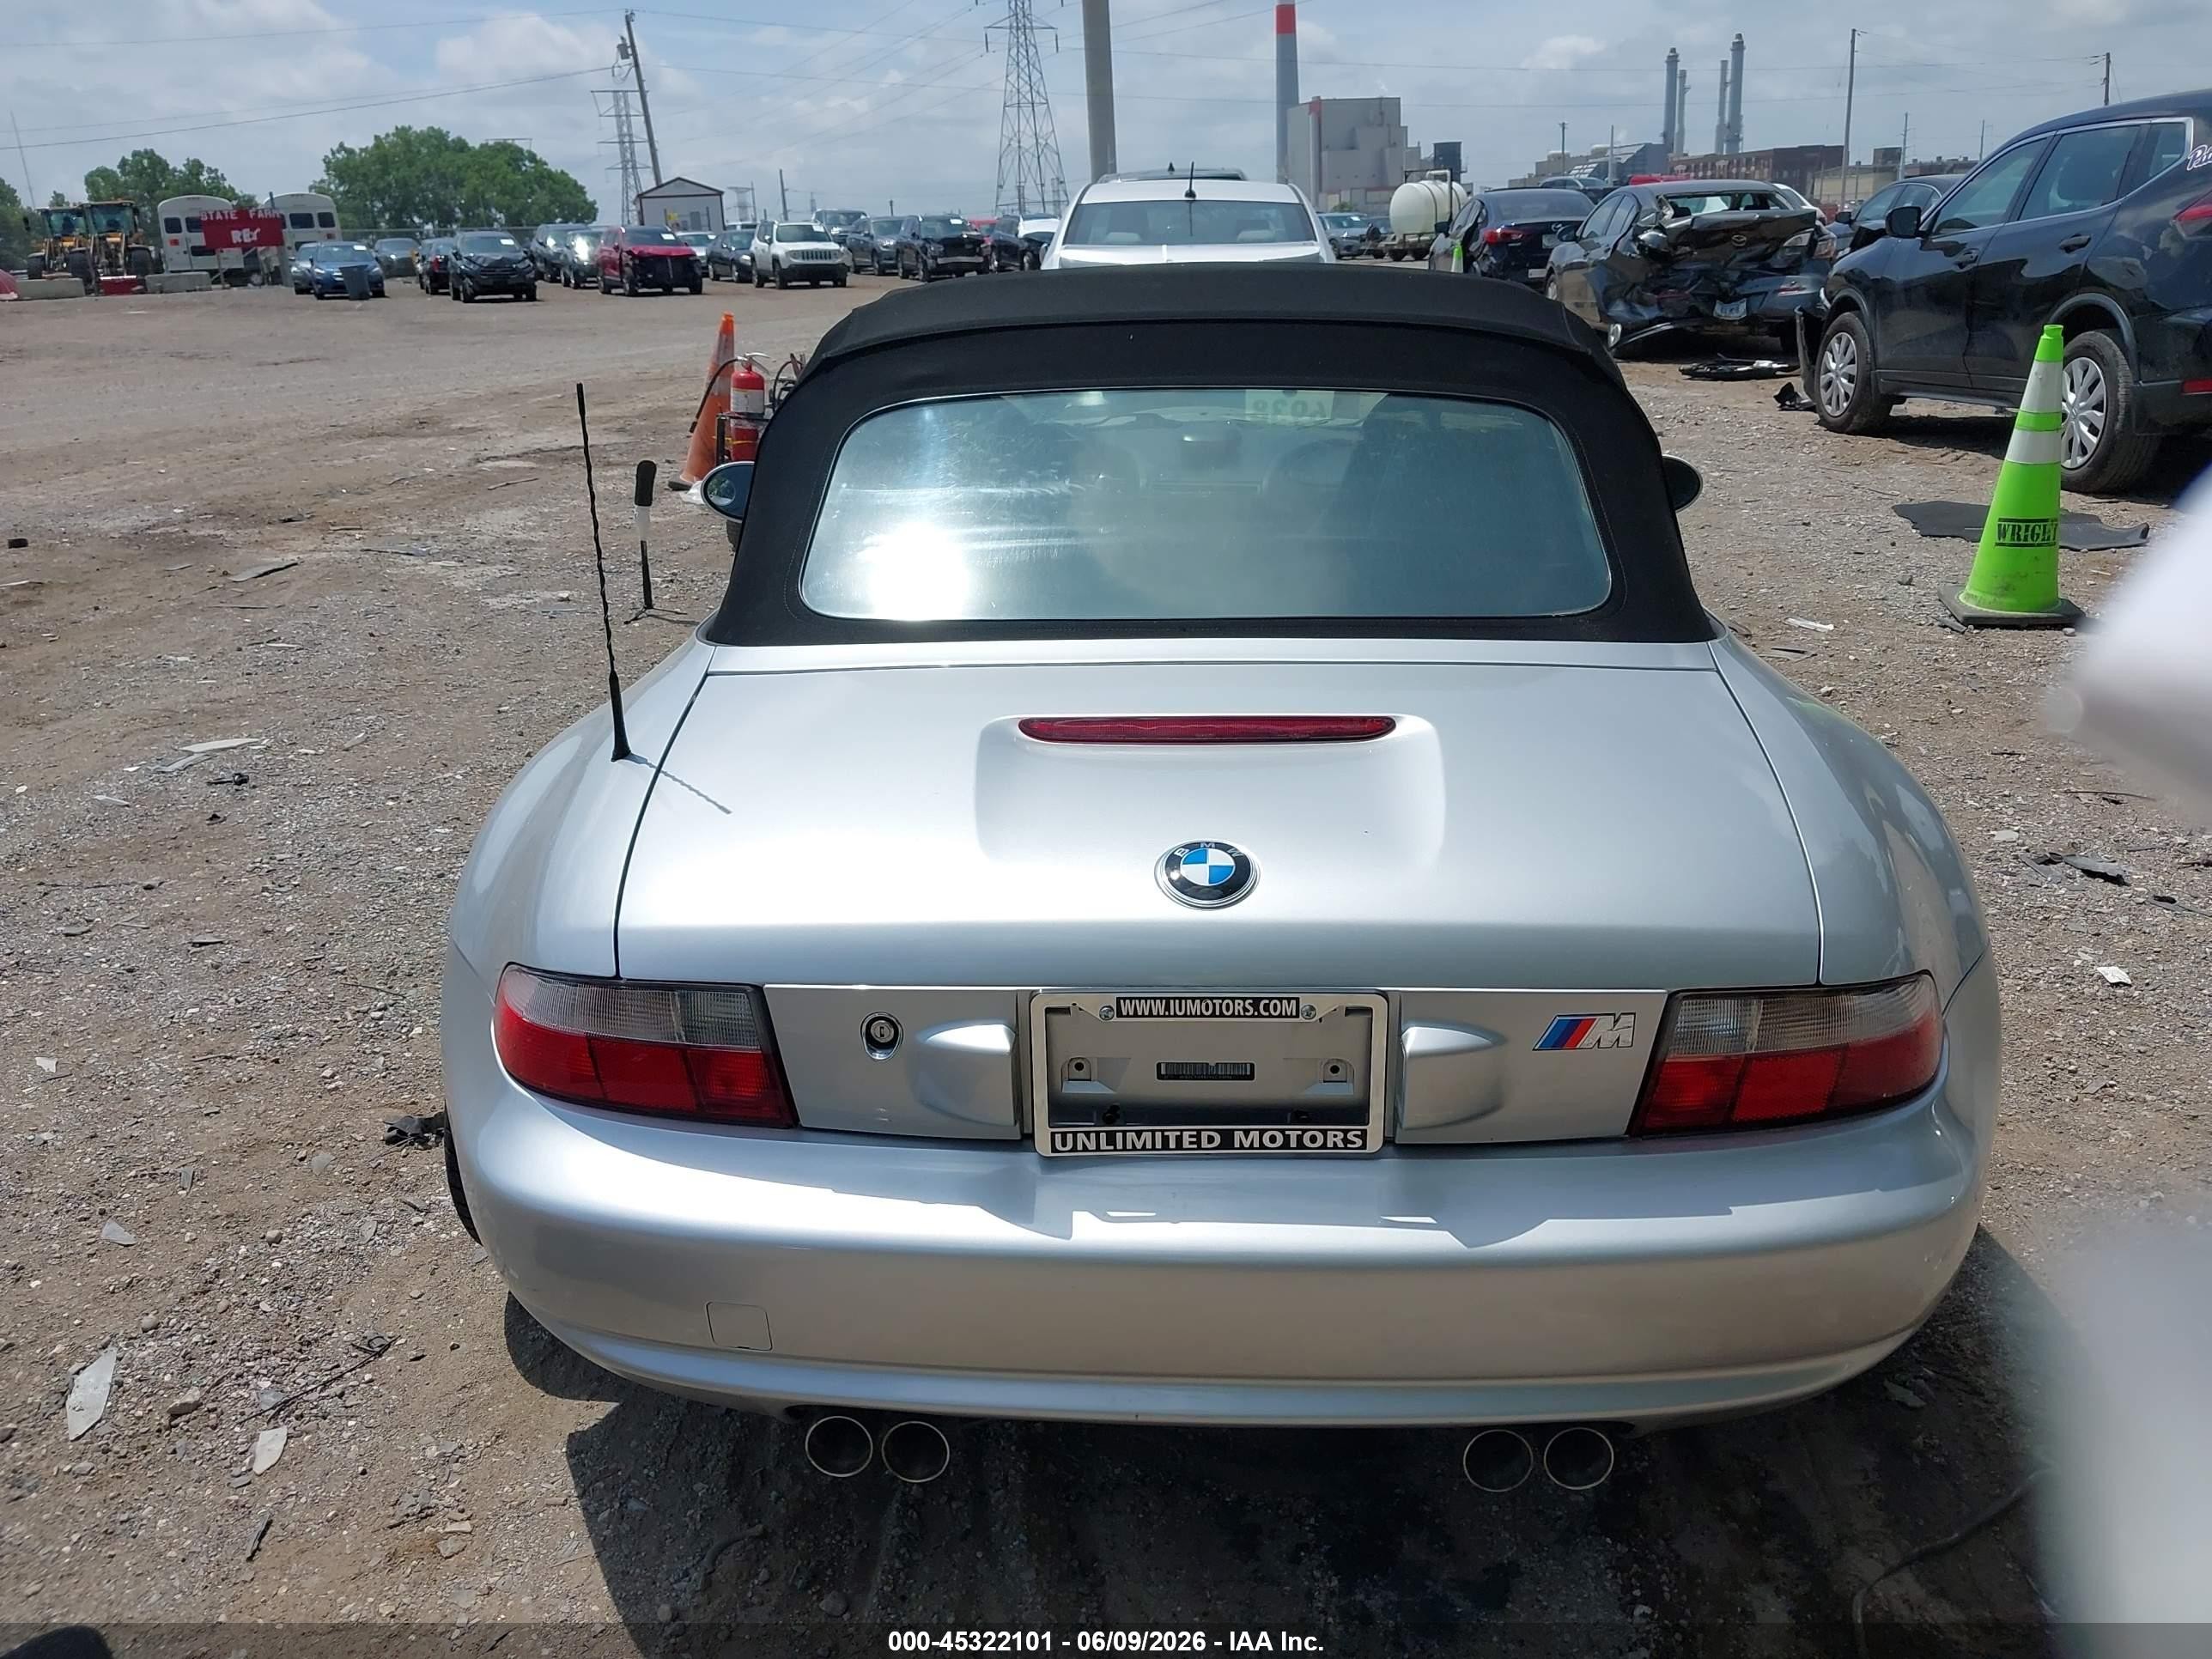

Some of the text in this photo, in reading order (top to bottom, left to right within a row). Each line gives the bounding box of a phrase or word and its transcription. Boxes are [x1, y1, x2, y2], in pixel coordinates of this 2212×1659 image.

[200, 210, 239, 221] STATE
[1120, 998, 1297, 1017] WWW.IUMOTORS.COM
[1054, 1129, 1364, 1152] UNLIMITED MOTORS
